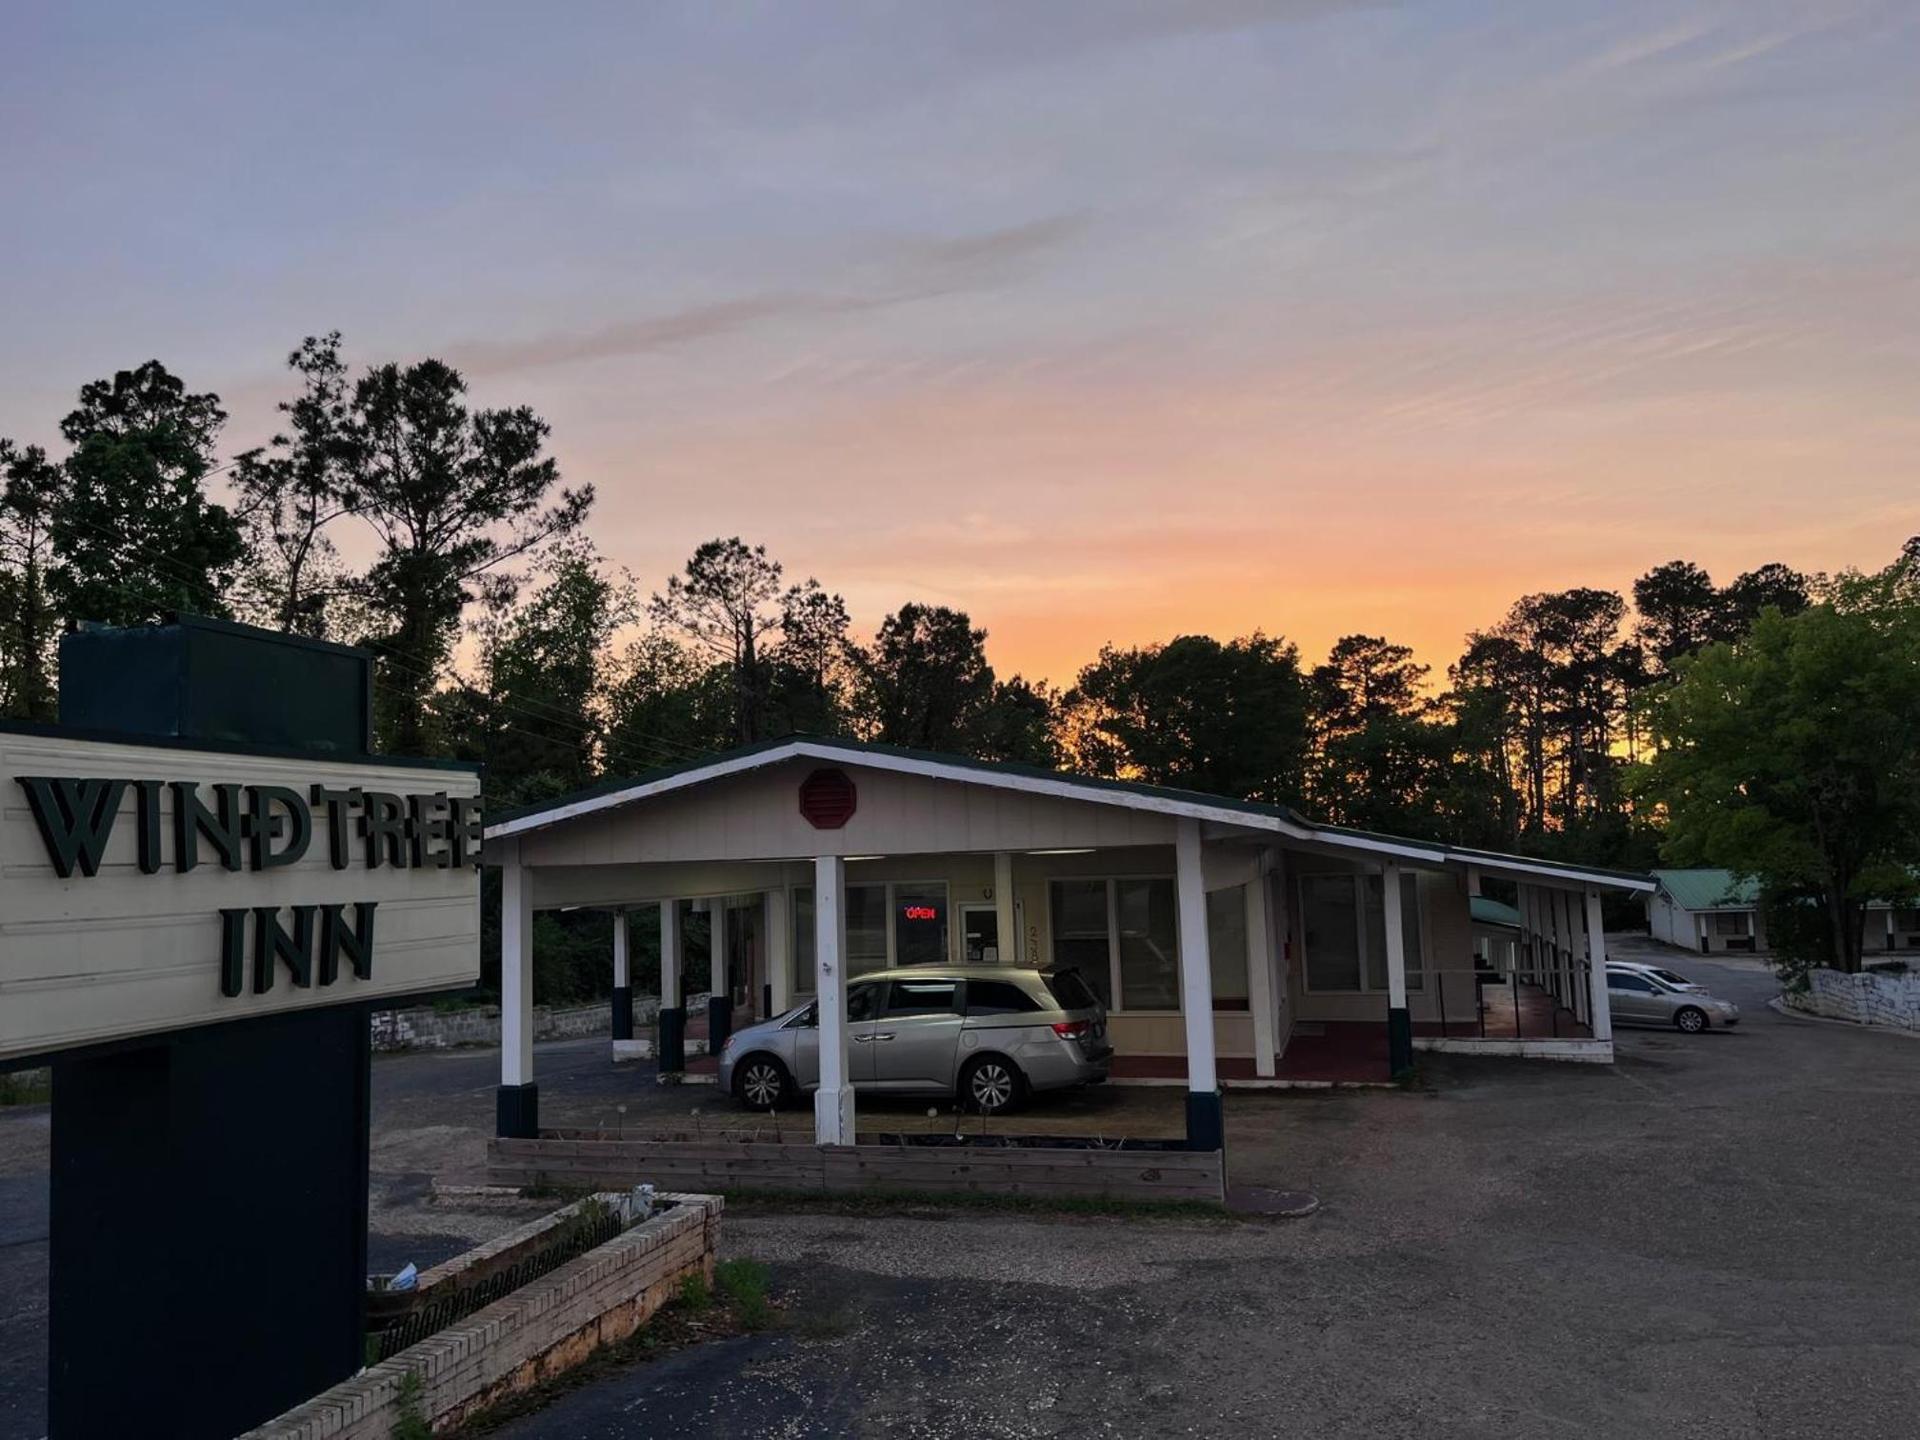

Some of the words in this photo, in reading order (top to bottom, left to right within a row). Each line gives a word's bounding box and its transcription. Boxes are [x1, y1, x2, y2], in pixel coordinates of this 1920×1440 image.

[14, 776, 484, 878] WINDTREE
[219, 902, 378, 997] INN
[905, 907, 936, 919] OPEN
